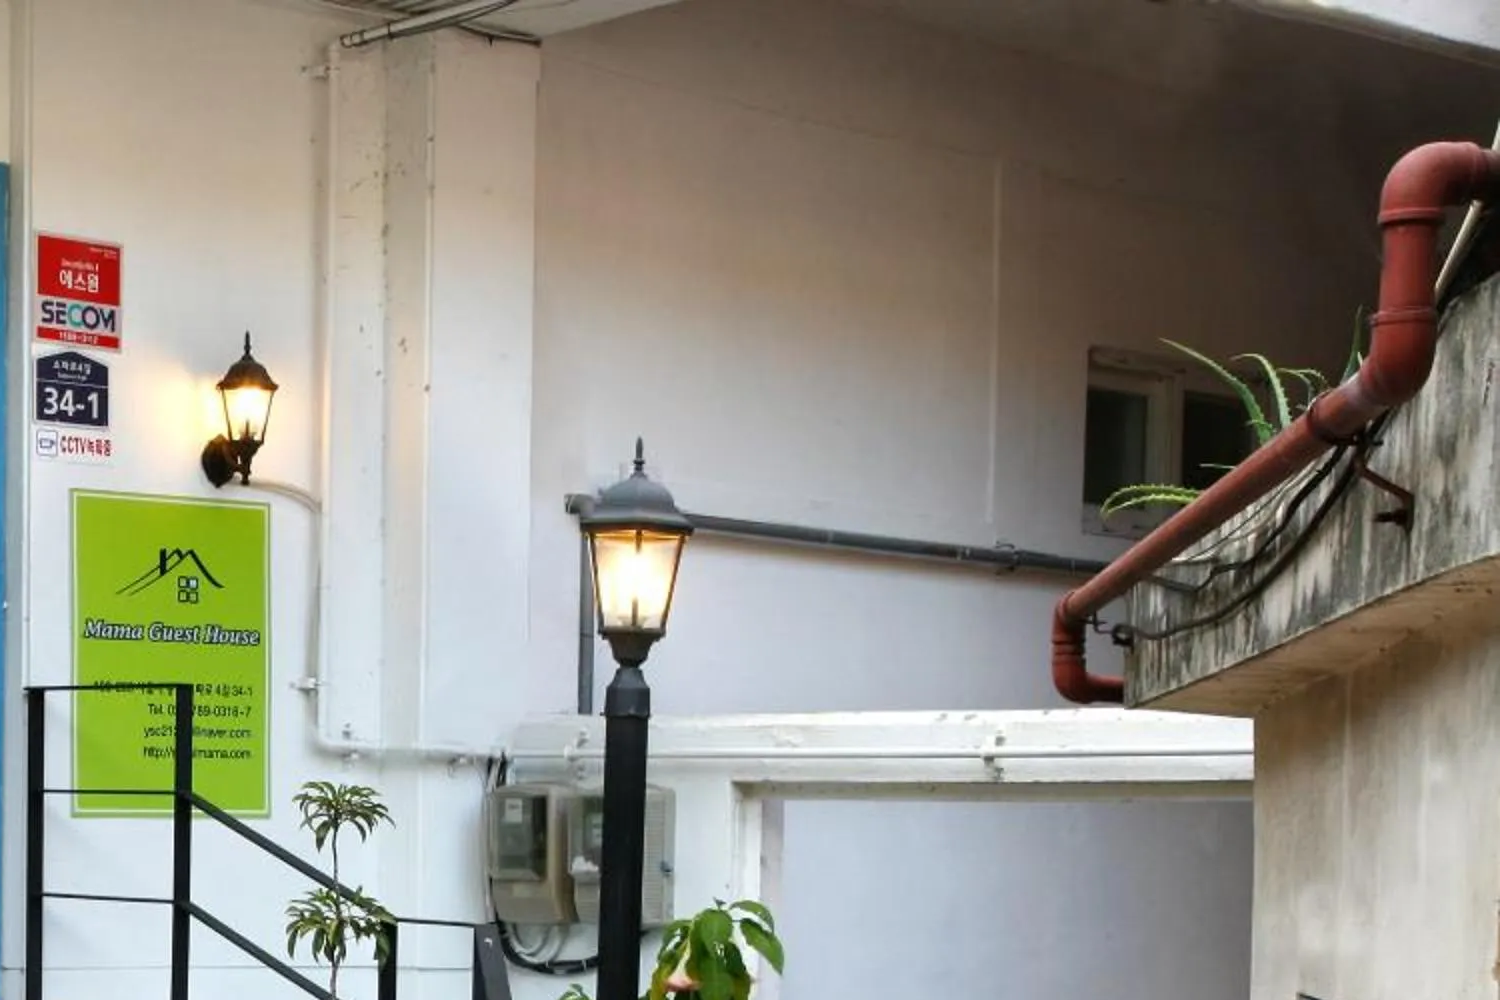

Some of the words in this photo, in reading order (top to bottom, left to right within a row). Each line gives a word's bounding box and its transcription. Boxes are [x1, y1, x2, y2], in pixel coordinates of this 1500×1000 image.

[41, 300, 116, 333] SECOM
[43, 386, 99, 419] 34-1
[84, 618, 144, 640] Mama
[148, 621, 200, 642] Guest
[203, 623, 260, 645] House
